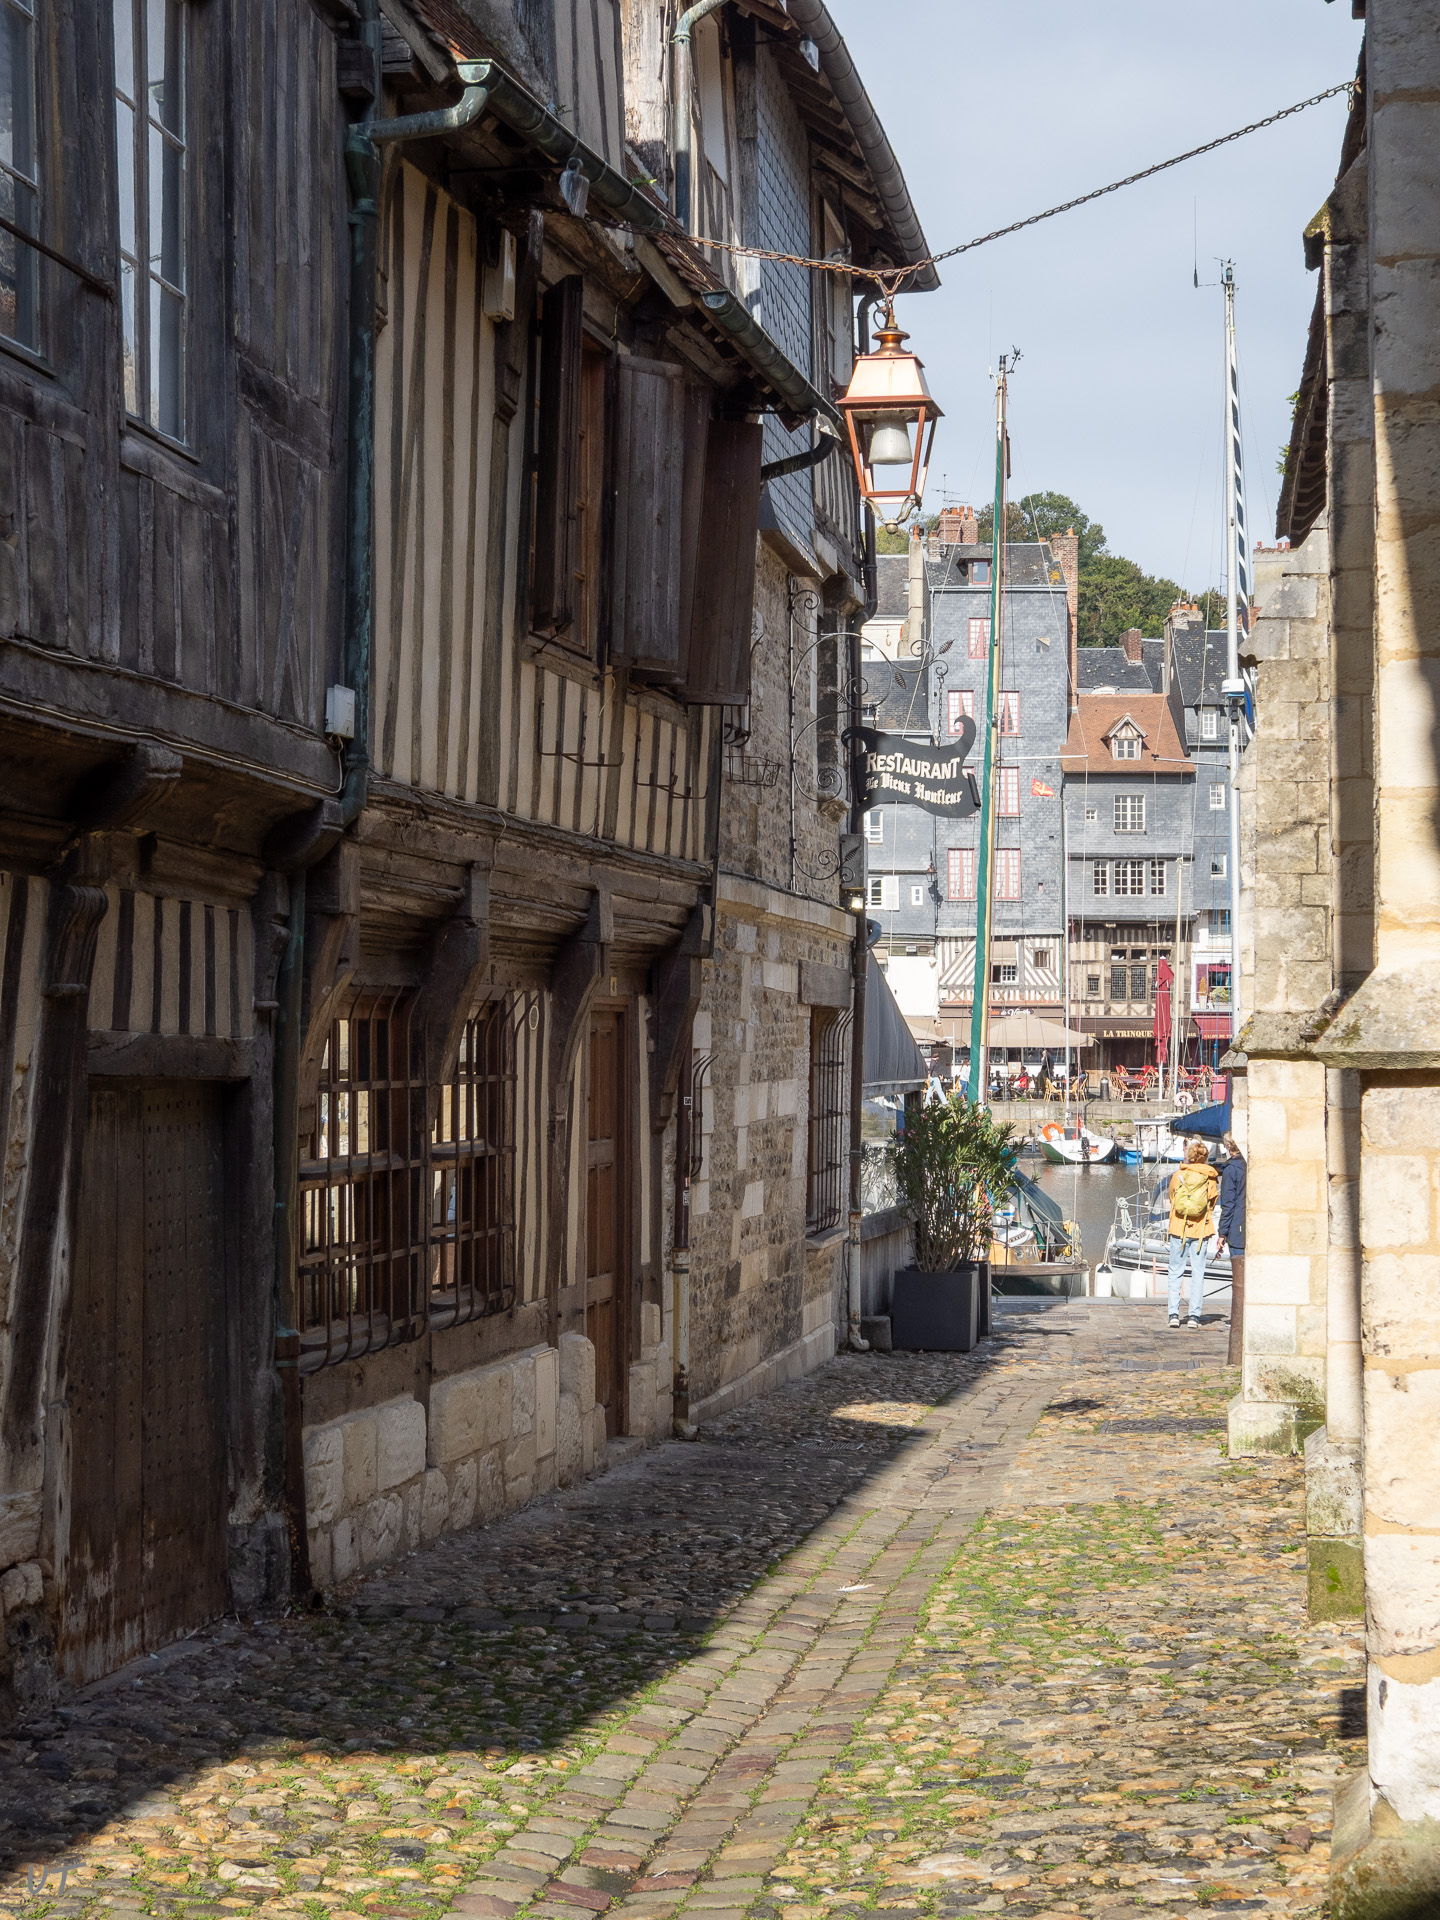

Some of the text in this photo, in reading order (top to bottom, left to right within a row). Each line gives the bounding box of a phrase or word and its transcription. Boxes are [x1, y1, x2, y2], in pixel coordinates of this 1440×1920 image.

[865, 752, 961, 780] RESTAURANT
[865, 772, 963, 805] Le Vieux Honfleur
[1103, 1029, 1114, 1038] LA
